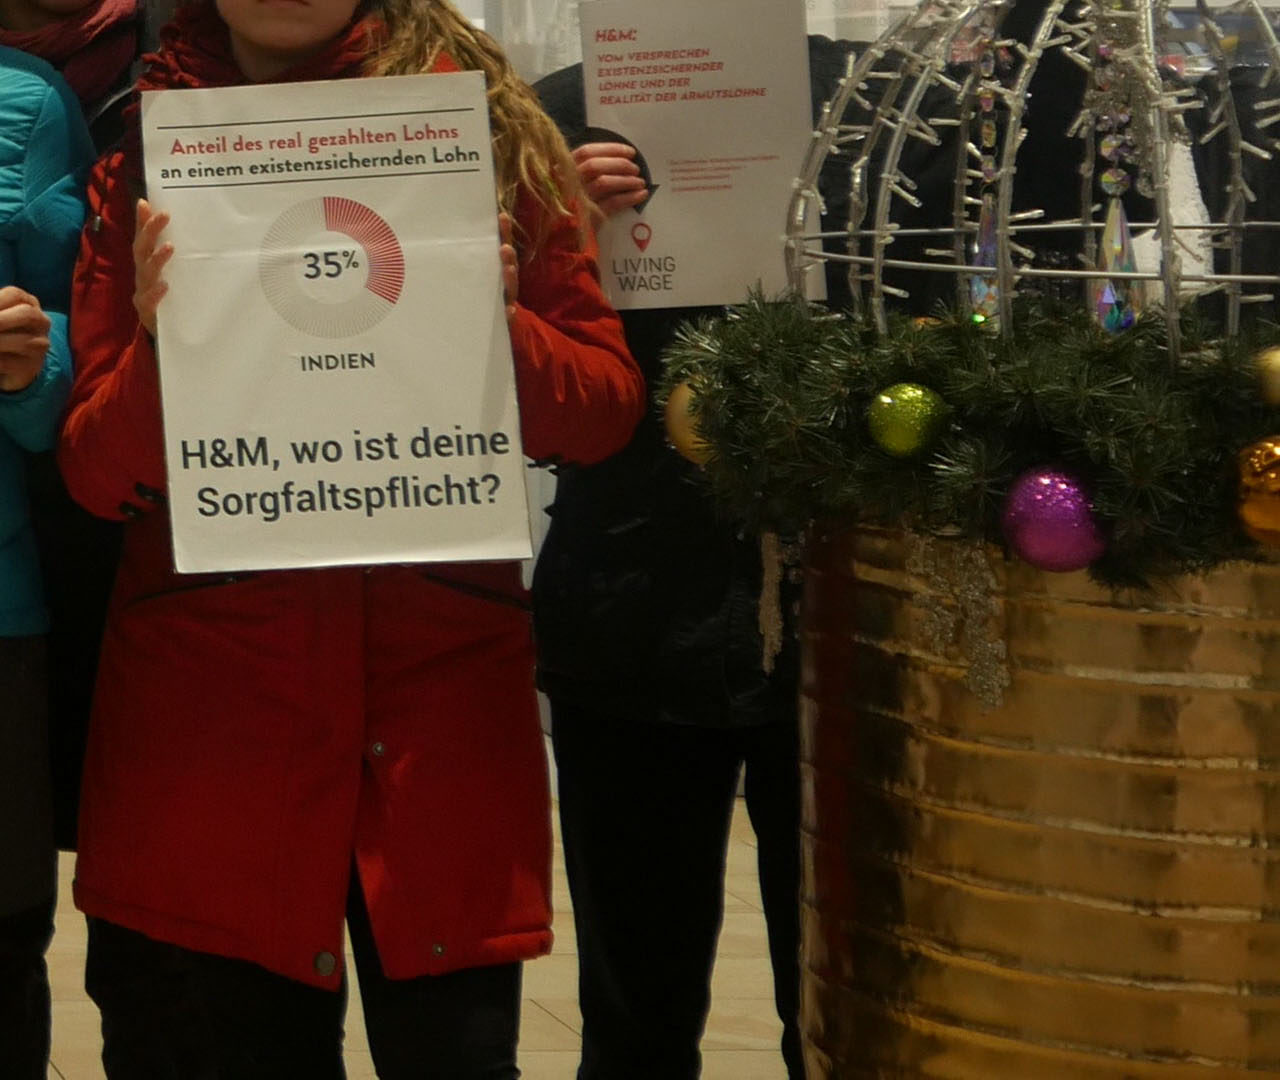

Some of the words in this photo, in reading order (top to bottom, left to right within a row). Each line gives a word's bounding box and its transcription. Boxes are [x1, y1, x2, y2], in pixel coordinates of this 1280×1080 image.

[598, 53, 624, 63] VOM
[627, 49, 710, 62] VERSPRECHEN
[597, 62, 724, 77] EXISTENZSICHERNDER
[640, 78, 665, 89] UND
[668, 77, 690, 88] DER
[655, 91, 677, 102] DER
[170, 137, 227, 156] Anteil
[233, 134, 263, 153] des
[269, 132, 302, 151] real
[308, 128, 396, 154] gezahlten
[402, 124, 459, 142] Lohns
[161, 165, 182, 179] an
[187, 161, 244, 178] einem
[249, 150, 426, 175] existenzsichernden
[433, 146, 480, 164] Lohn
[303, 249, 359, 280] 35%
[612, 256, 676, 275] LIVING
[618, 274, 673, 291] WAGE
[301, 353, 376, 372] INDIEN
[180, 436, 280, 471] H&M,
[291, 440, 343, 464] wo
[354, 429, 399, 461] ist
[410, 425, 510, 458] deine
[197, 473, 501, 521] Sorgfaltspflicht?
